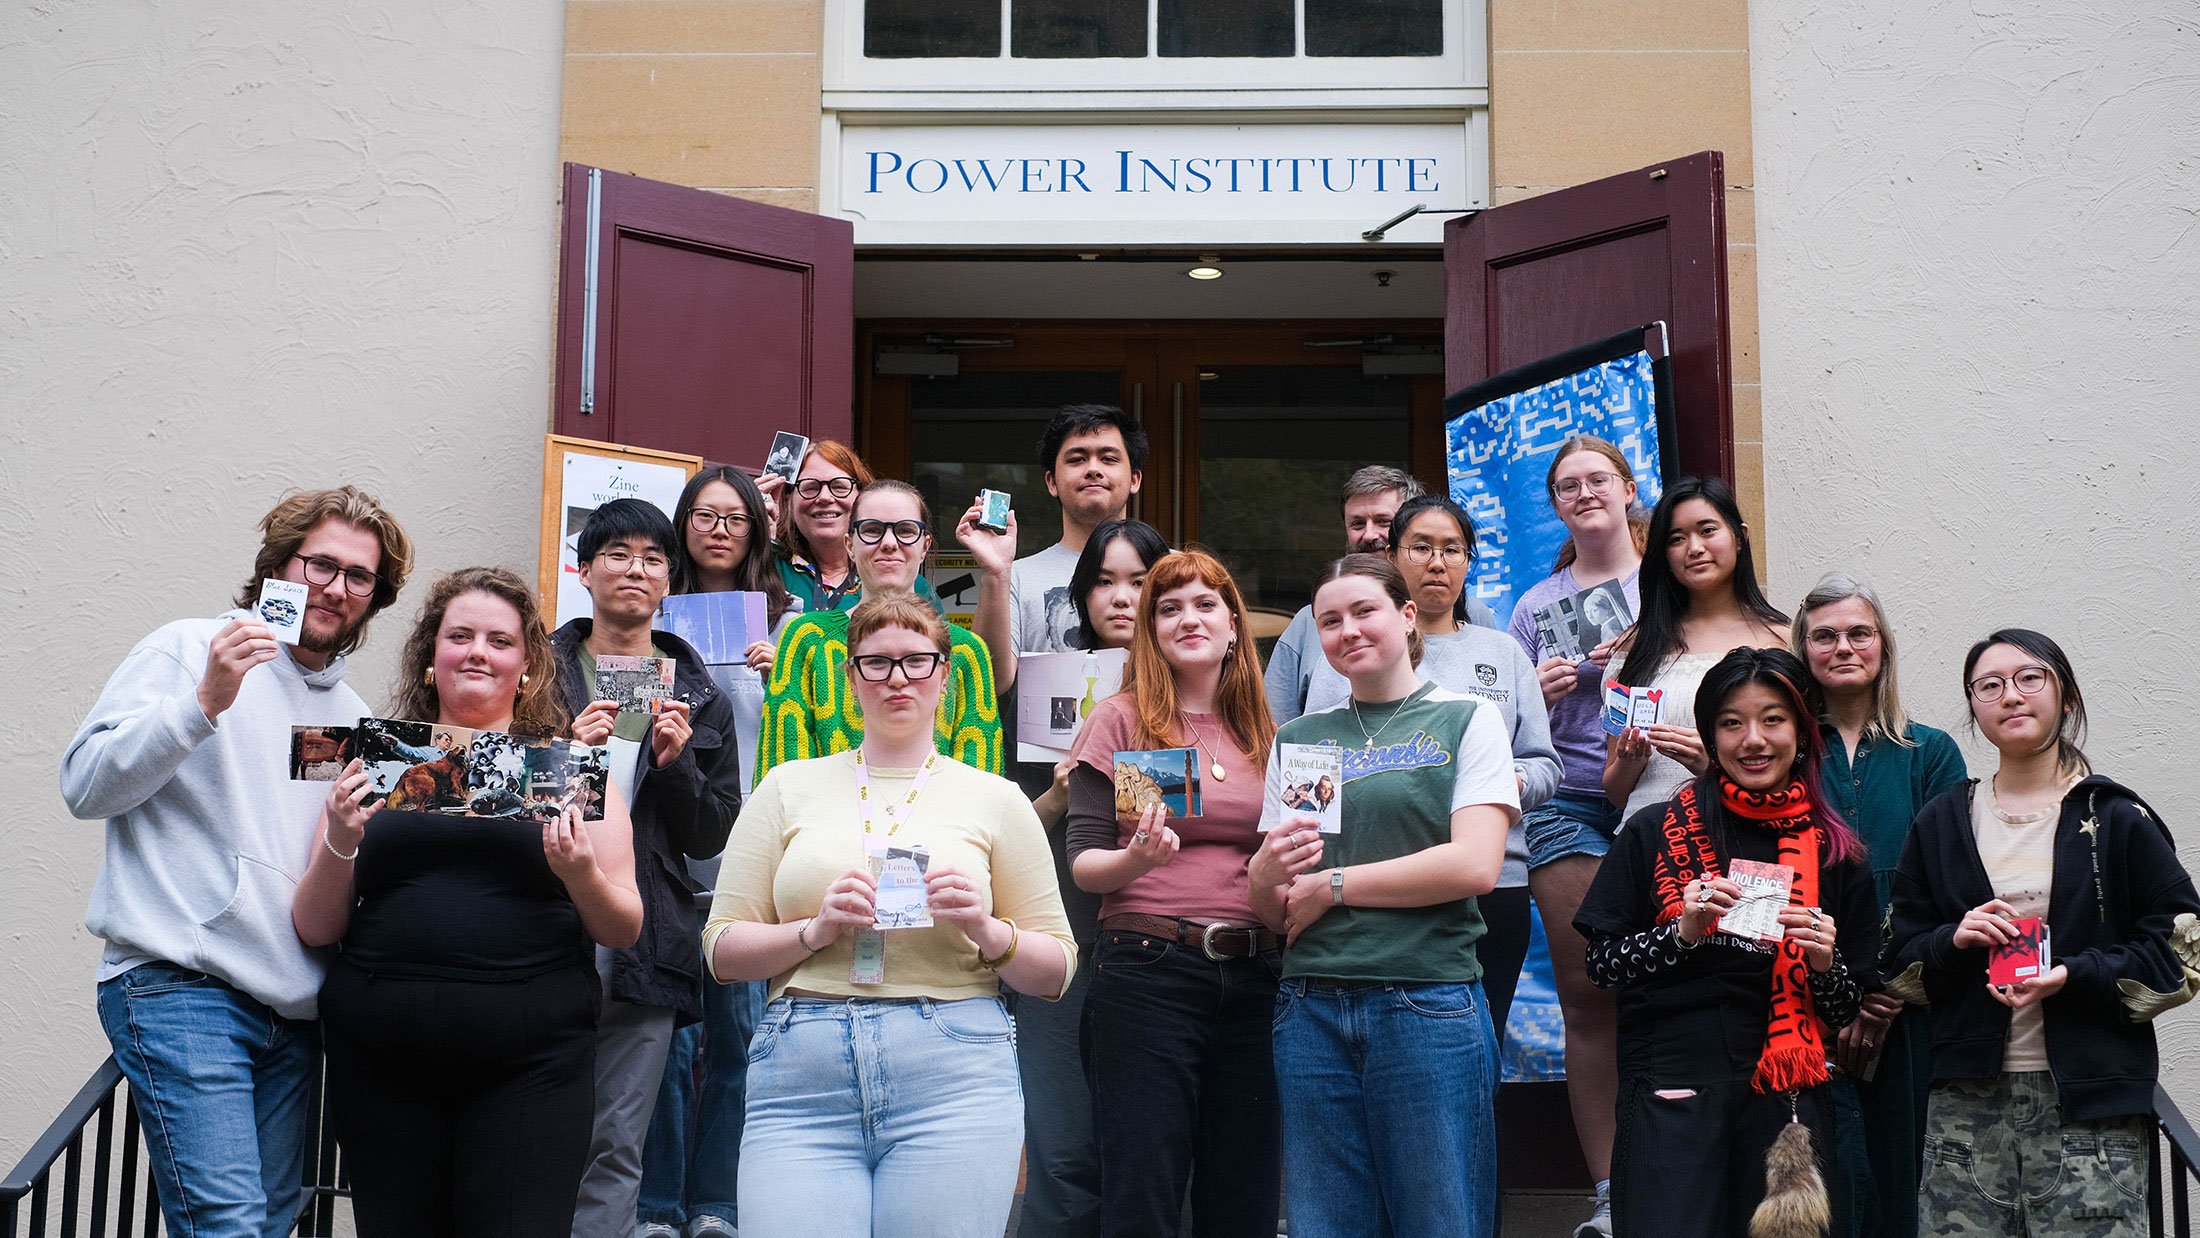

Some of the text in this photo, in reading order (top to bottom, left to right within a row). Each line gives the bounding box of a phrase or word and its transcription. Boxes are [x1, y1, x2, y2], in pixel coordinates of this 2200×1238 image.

[864, 149, 1439, 194] POWER INSTITUTE
[609, 474, 639, 492] Zine
[1315, 760, 1329, 770] Life
[887, 863, 916, 872] Letters
[1730, 871, 1784, 890] VIOLENCE
